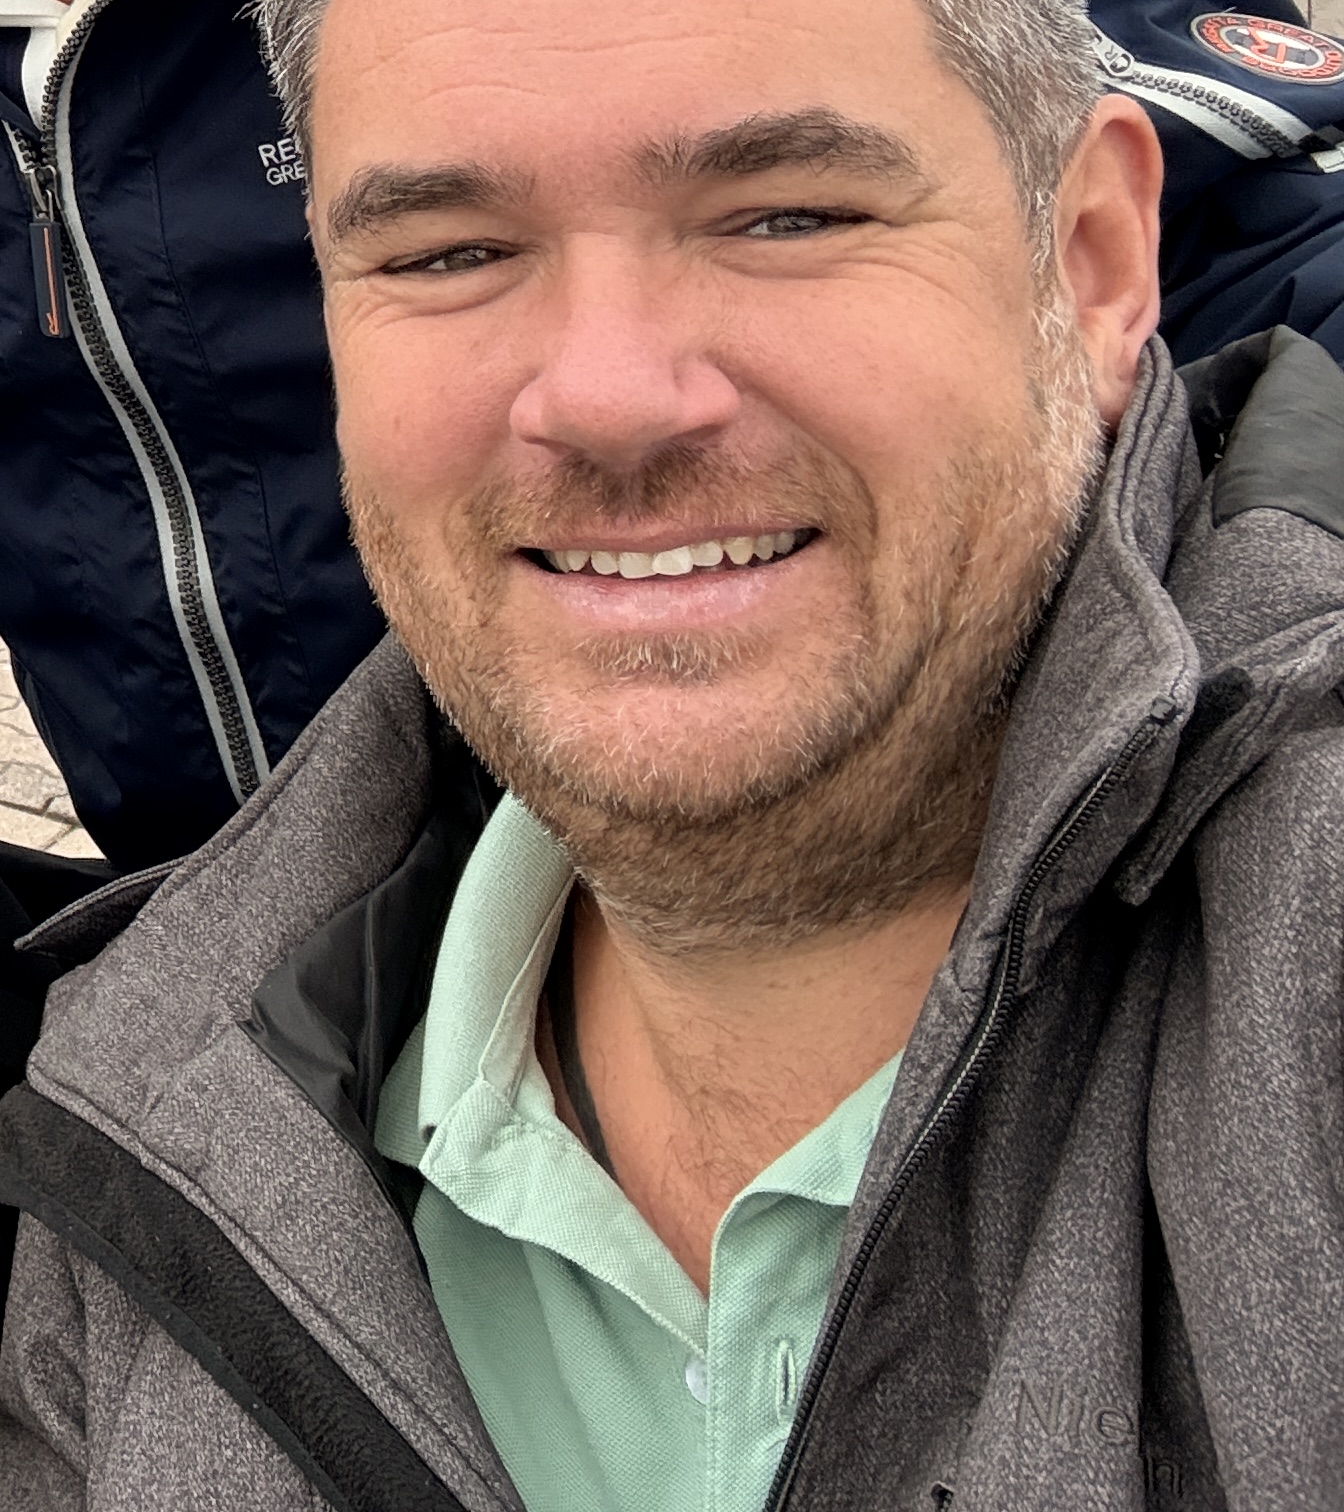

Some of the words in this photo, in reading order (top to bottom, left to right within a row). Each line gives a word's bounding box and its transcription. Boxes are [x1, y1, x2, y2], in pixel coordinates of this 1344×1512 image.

[1247, 18, 1330, 48] GREAT
[257, 138, 297, 168] RE
[266, 161, 307, 186] GRE
